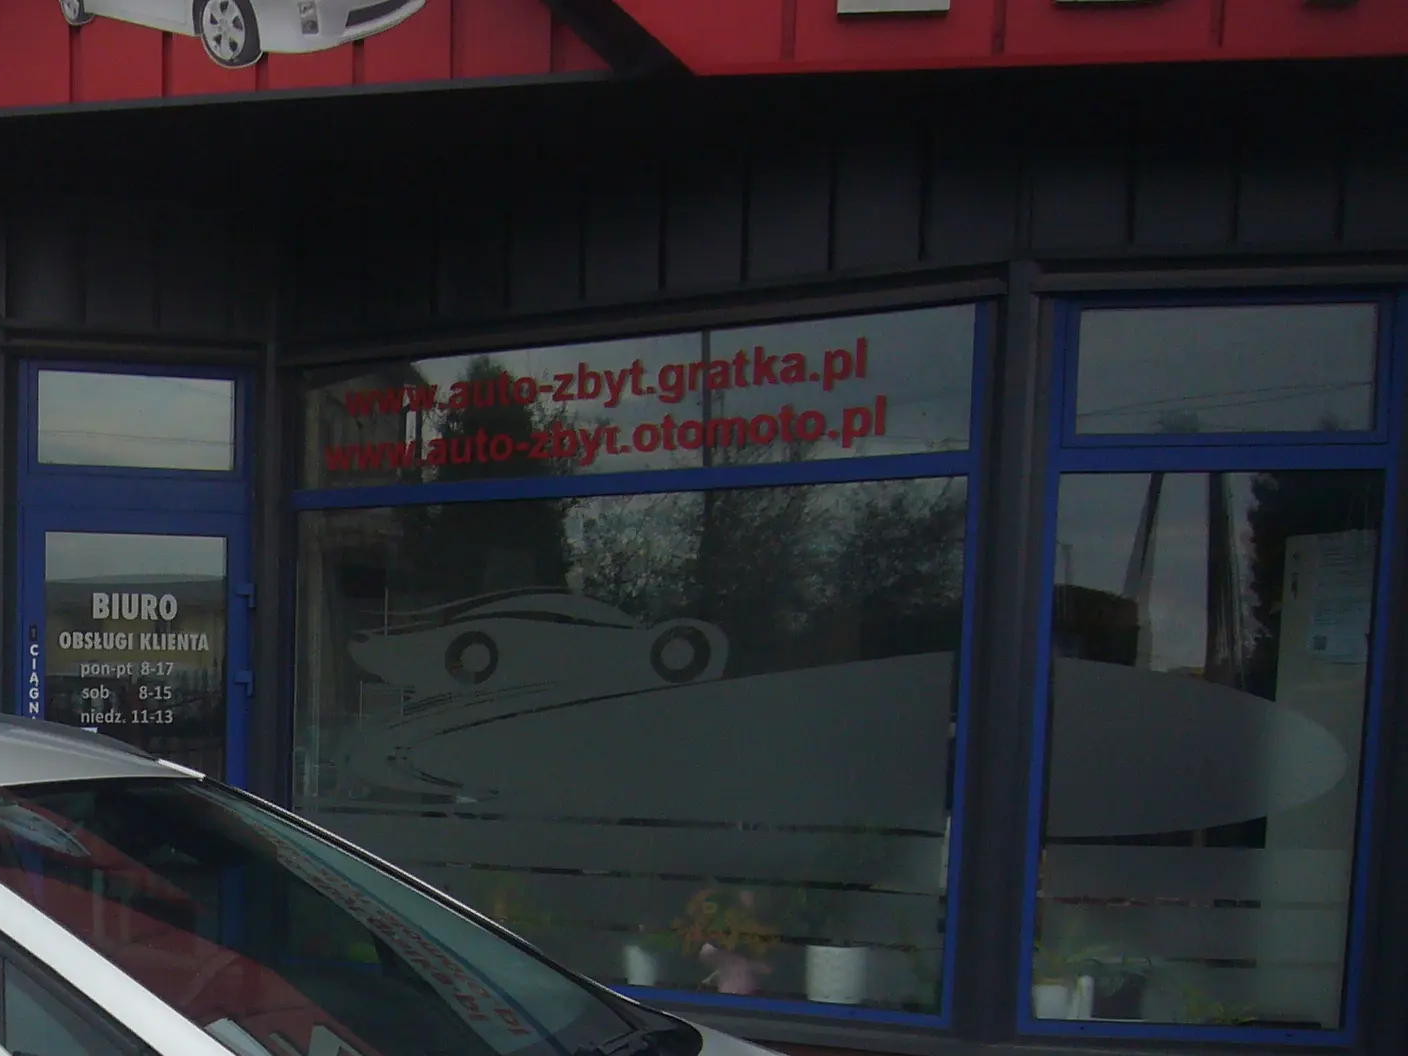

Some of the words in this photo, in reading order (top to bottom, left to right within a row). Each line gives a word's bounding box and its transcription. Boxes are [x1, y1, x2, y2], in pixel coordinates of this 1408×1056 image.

[345, 336, 870, 417] www.auto-zbyt.gratka.pl
[323, 393, 888, 471] www.auto-zbyt.otomoto.pl
[92, 592, 178, 621] BIURO
[58, 631, 133, 650] OBSŁUGI
[140, 632, 209, 651] KLIENTA
[28, 643, 40, 721] CIĄGN
[80, 662, 133, 678] pon-pt
[140, 662, 174, 676] 8-17
[81, 684, 110, 700] sob
[138, 685, 173, 700] 8-15
[80, 709, 127, 724] niedz.
[131, 709, 174, 724] 11-13
